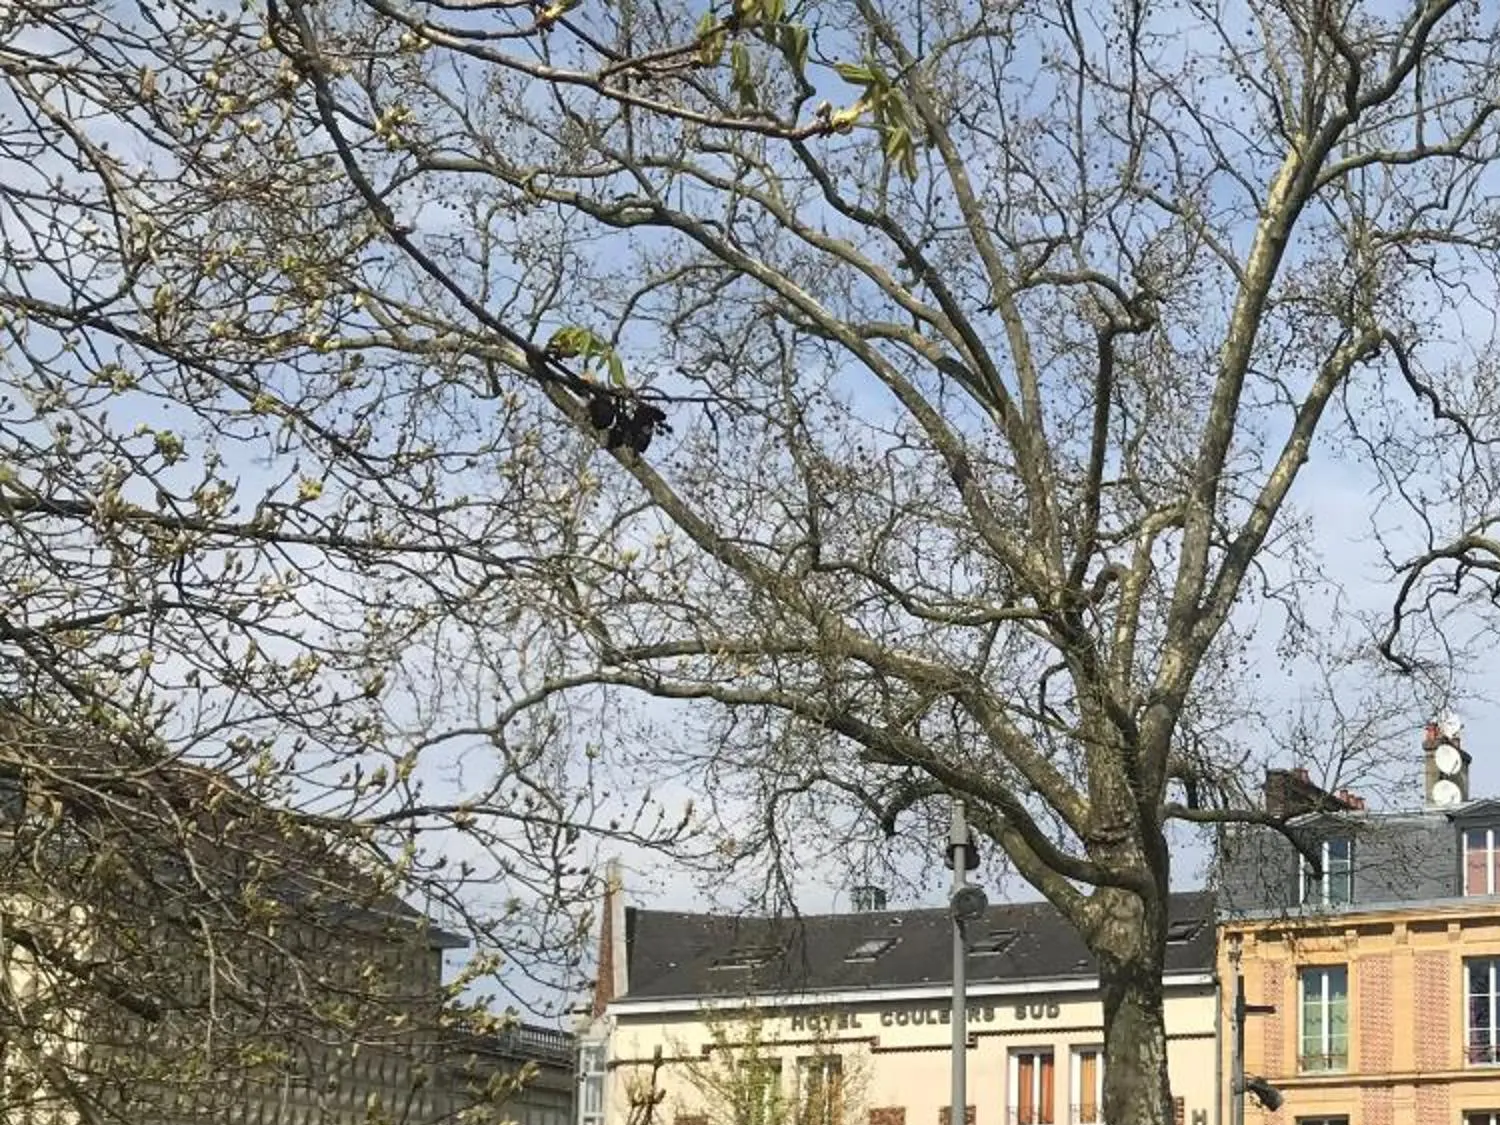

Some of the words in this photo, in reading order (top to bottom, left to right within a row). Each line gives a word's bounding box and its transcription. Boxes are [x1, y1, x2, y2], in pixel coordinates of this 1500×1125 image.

[791, 1011, 862, 1031] HOTEL
[880, 1007, 995, 1027] COULERS
[1014, 1004, 1060, 1020] SUD
